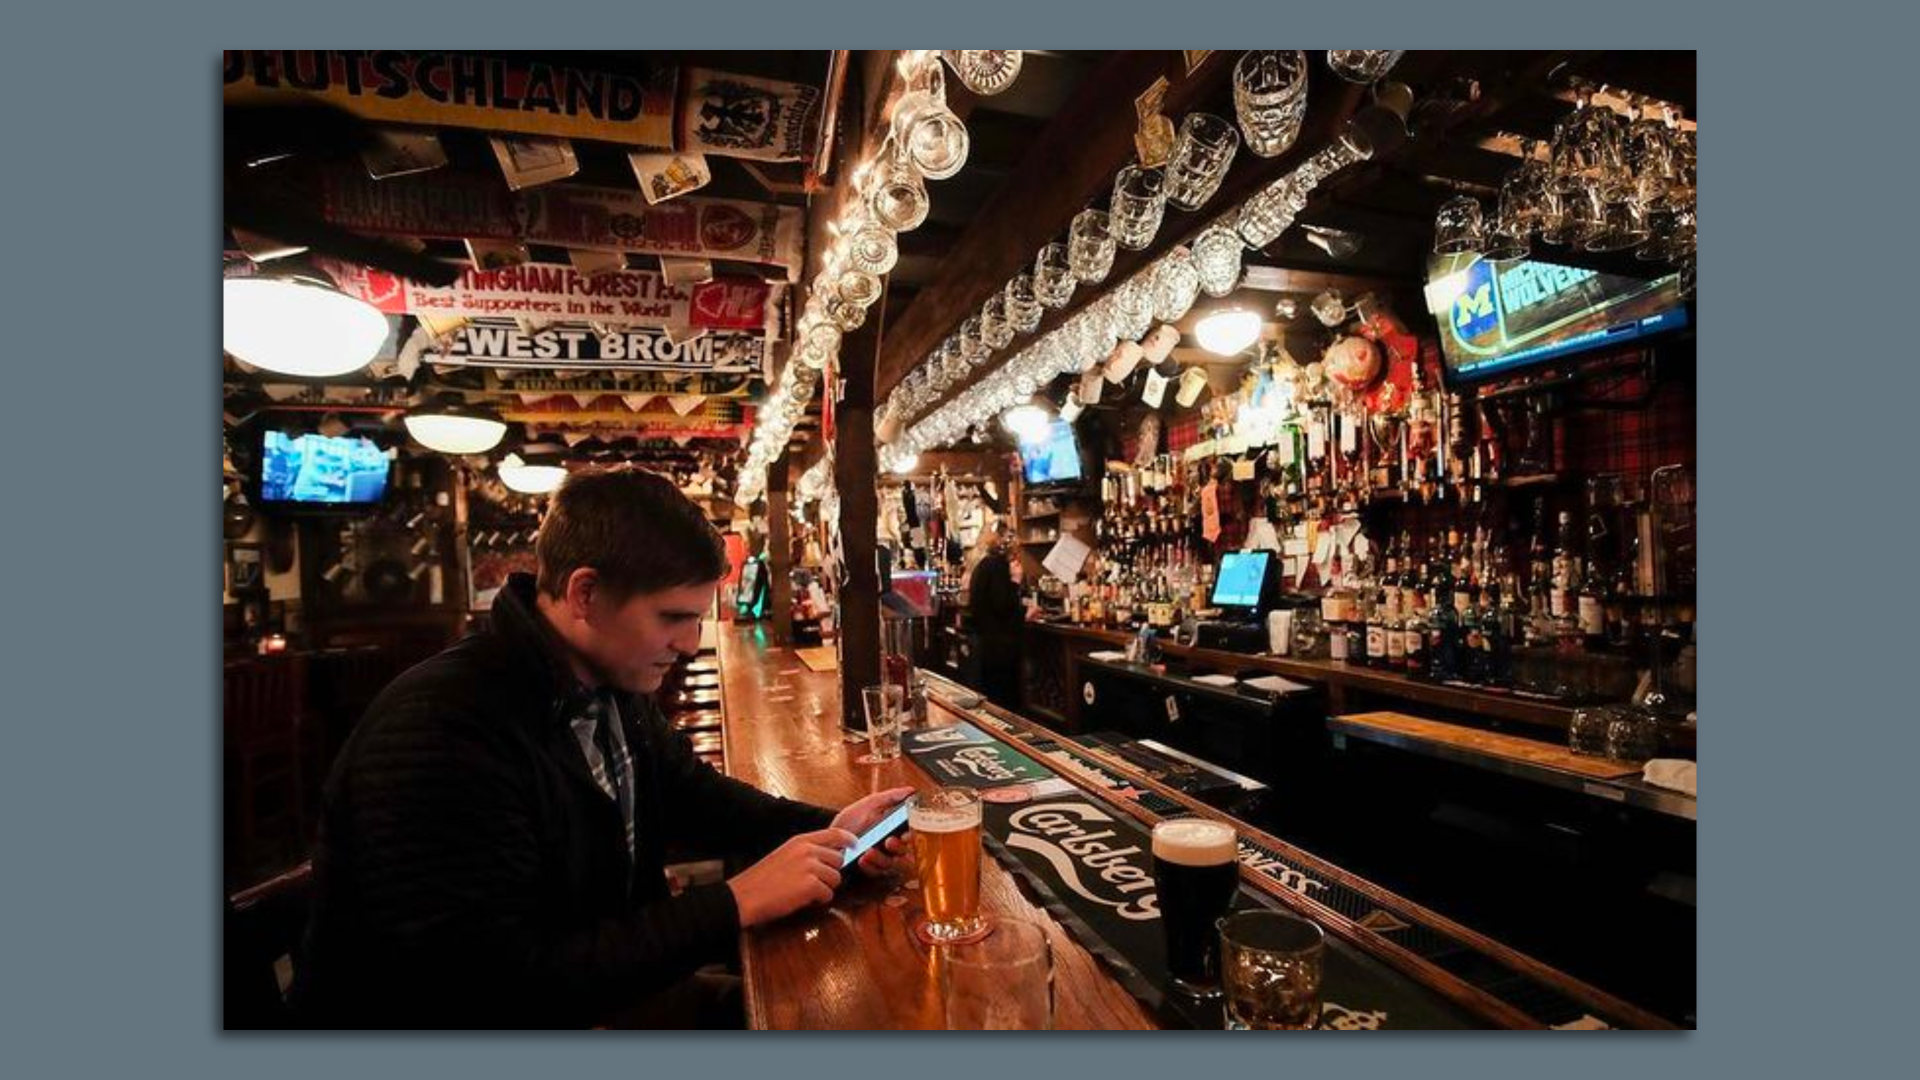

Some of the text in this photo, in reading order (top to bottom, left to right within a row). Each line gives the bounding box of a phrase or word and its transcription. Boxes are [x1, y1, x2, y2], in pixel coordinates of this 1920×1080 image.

[411, 264, 562, 293] TINGHAM
[567, 268, 651, 298] FOREST
[412, 291, 455, 308] Best
[462, 293, 562, 312] Supporters
[567, 299, 585, 313] in
[590, 300, 616, 314] the
[1456, 283, 1494, 327] M
[467, 328, 713, 362] WEST BROM
